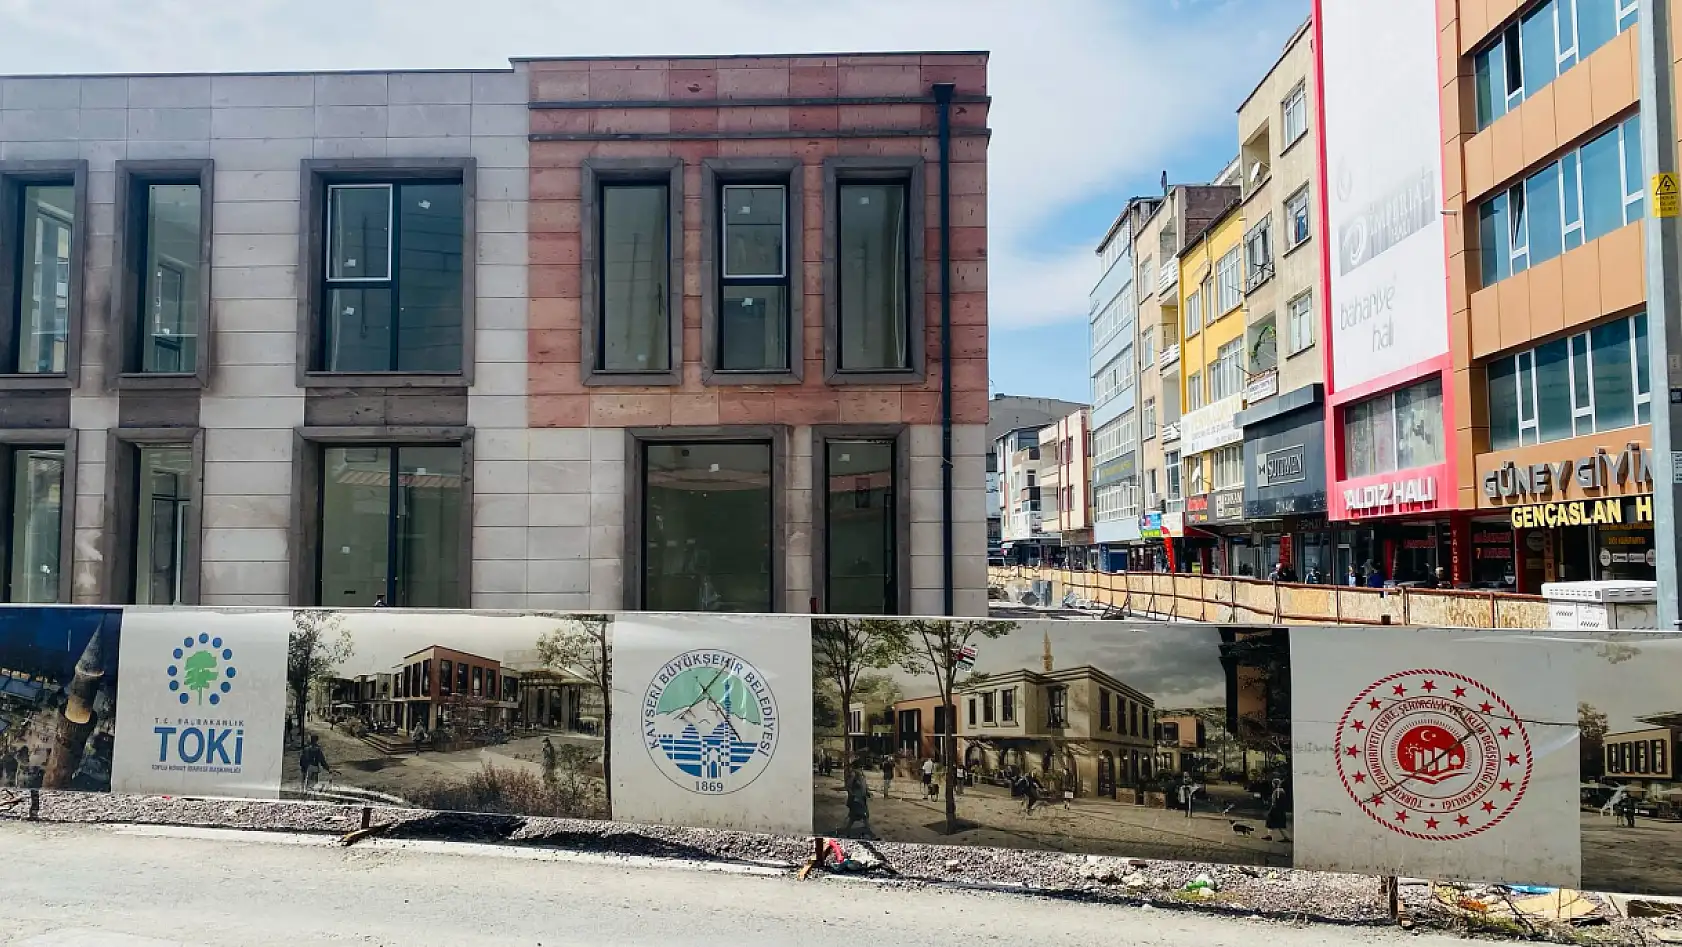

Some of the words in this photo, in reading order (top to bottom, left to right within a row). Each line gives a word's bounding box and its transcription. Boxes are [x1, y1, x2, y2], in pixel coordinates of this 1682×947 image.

[1392, 477, 1436, 505] HALI
[1483, 460, 1572, 498] GÜNEY
[1511, 498, 1622, 529] GENÇASLAN
[644, 682, 663, 750] KAYSERİ
[660, 653, 744, 685] BÜYÜKŞEHİR
[743, 671, 776, 757] BELEDİYESİ
[695, 780, 724, 792] 1869
